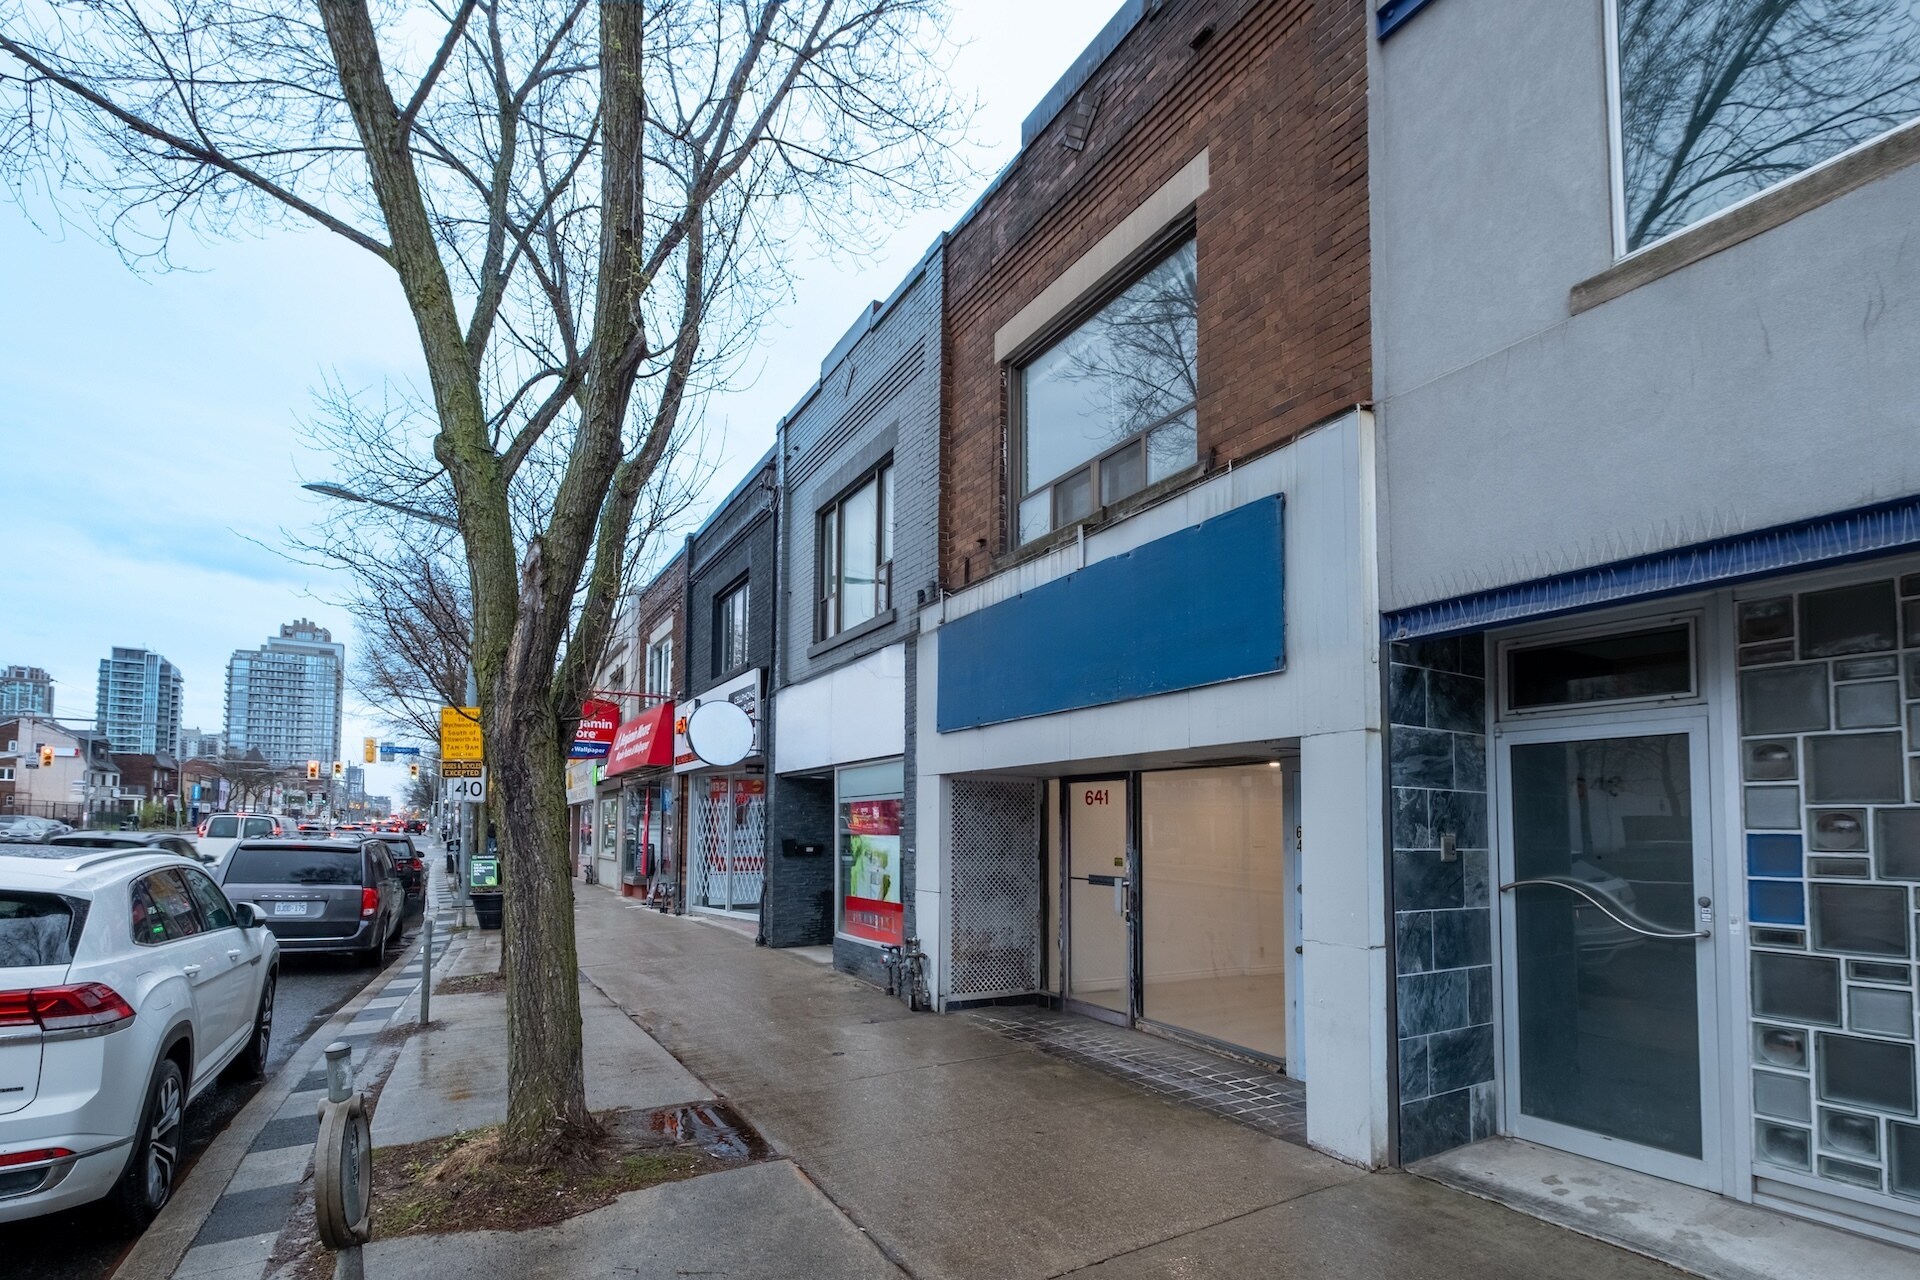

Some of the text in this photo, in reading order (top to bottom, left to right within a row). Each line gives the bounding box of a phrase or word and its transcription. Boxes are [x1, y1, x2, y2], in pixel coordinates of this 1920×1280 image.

[578, 719, 613, 730] jamin
[575, 730, 596, 739] ore
[574, 746, 605, 754] Wallpaper
[455, 781, 482, 796] 40
[1085, 789, 1109, 806] 641
